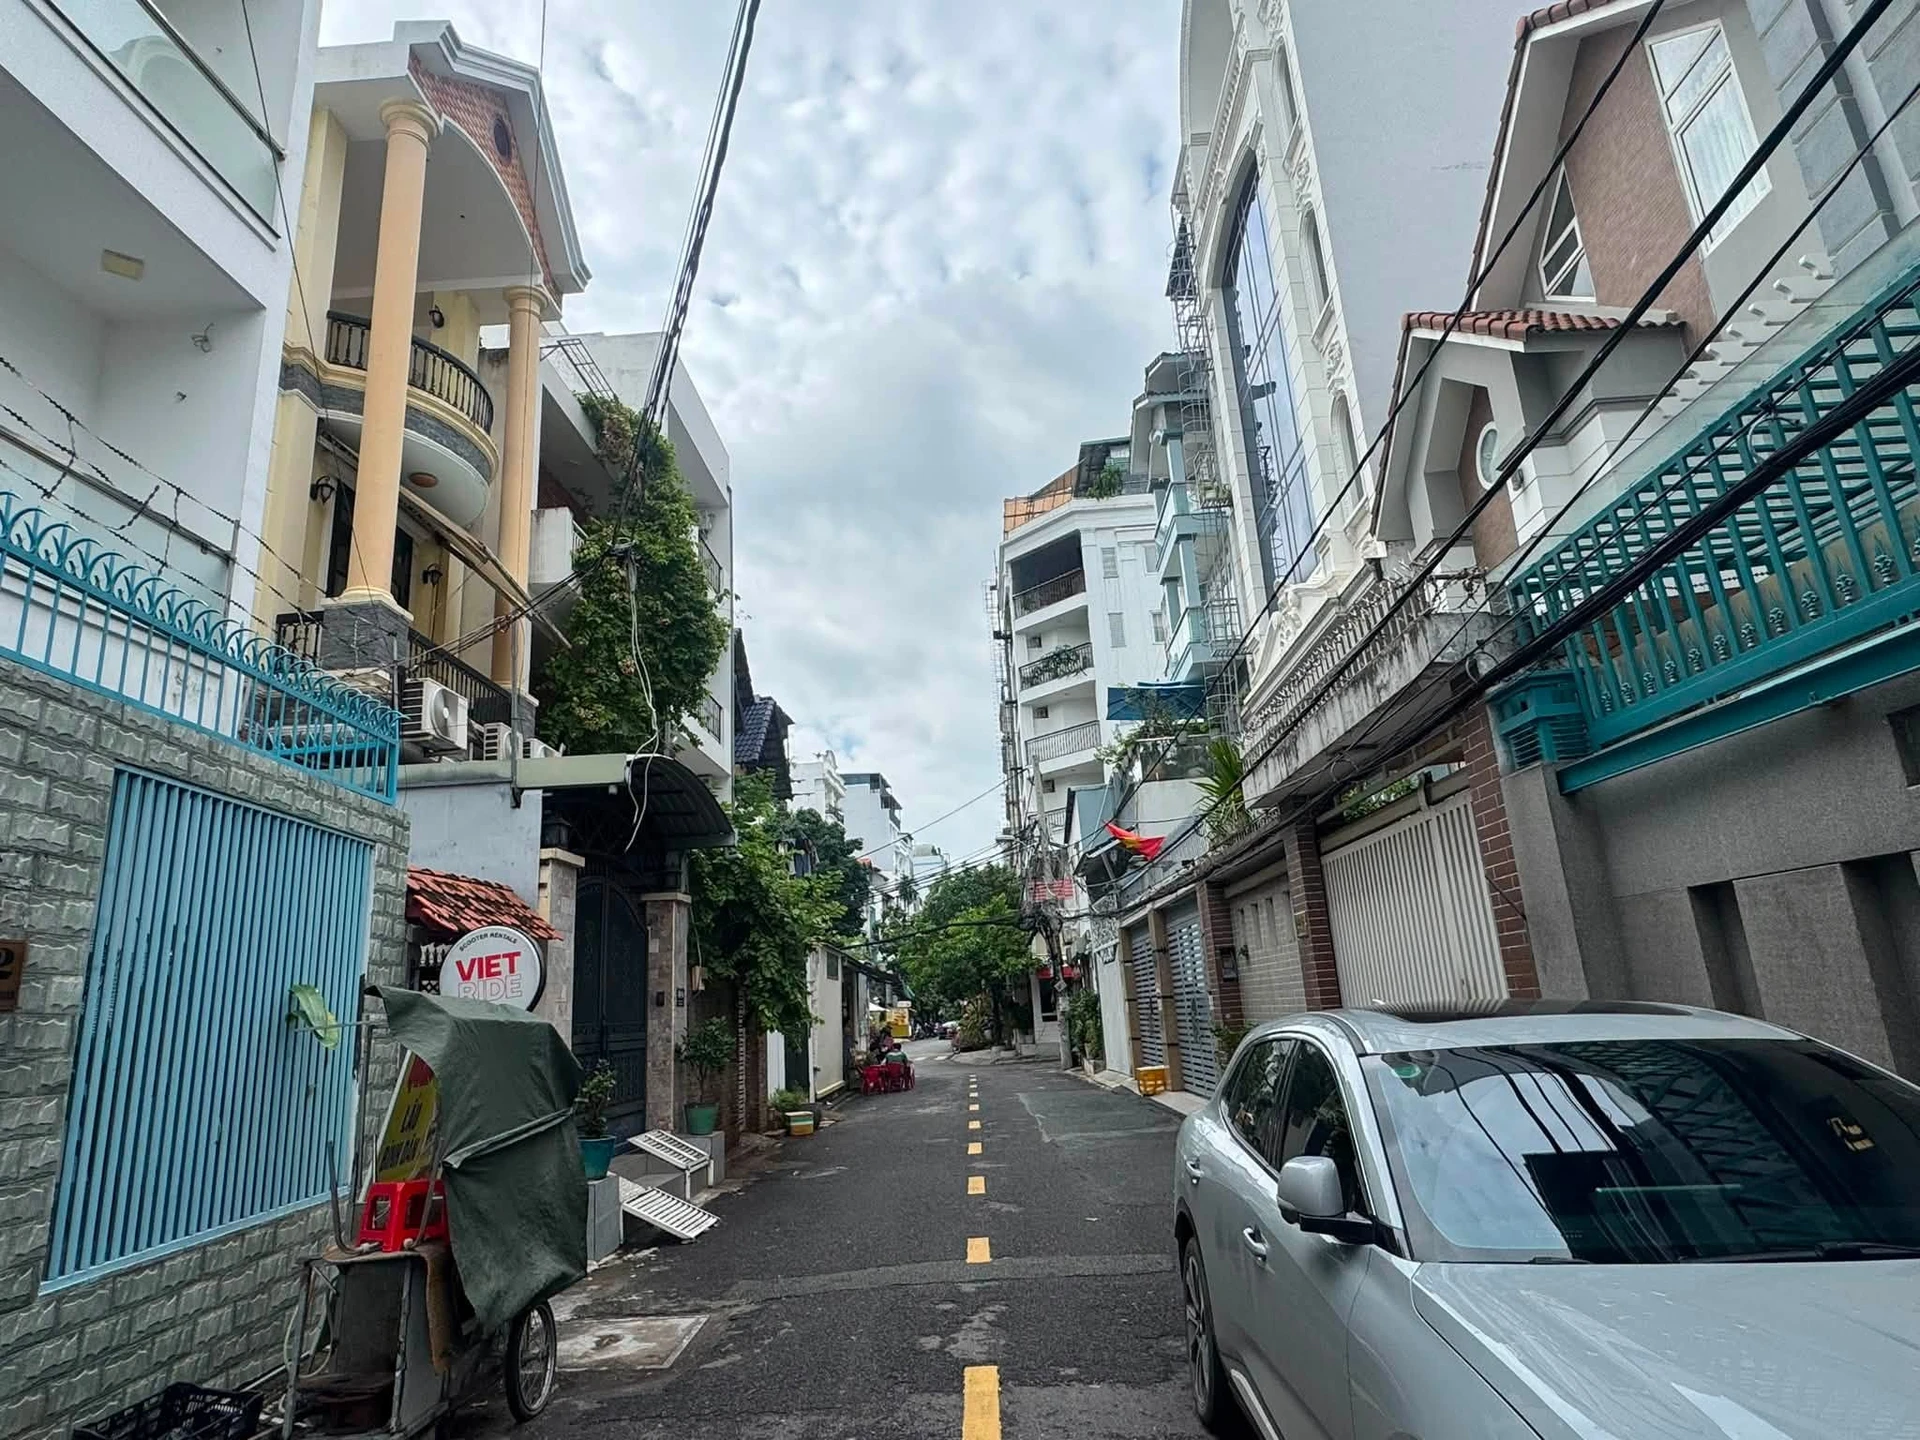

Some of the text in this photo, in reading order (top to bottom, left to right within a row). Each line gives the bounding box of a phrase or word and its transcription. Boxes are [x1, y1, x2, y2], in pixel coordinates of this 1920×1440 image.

[459, 932, 488, 951] SCOOTER
[455, 951, 521, 981] VIET
[458, 974, 523, 1001] RIDE
